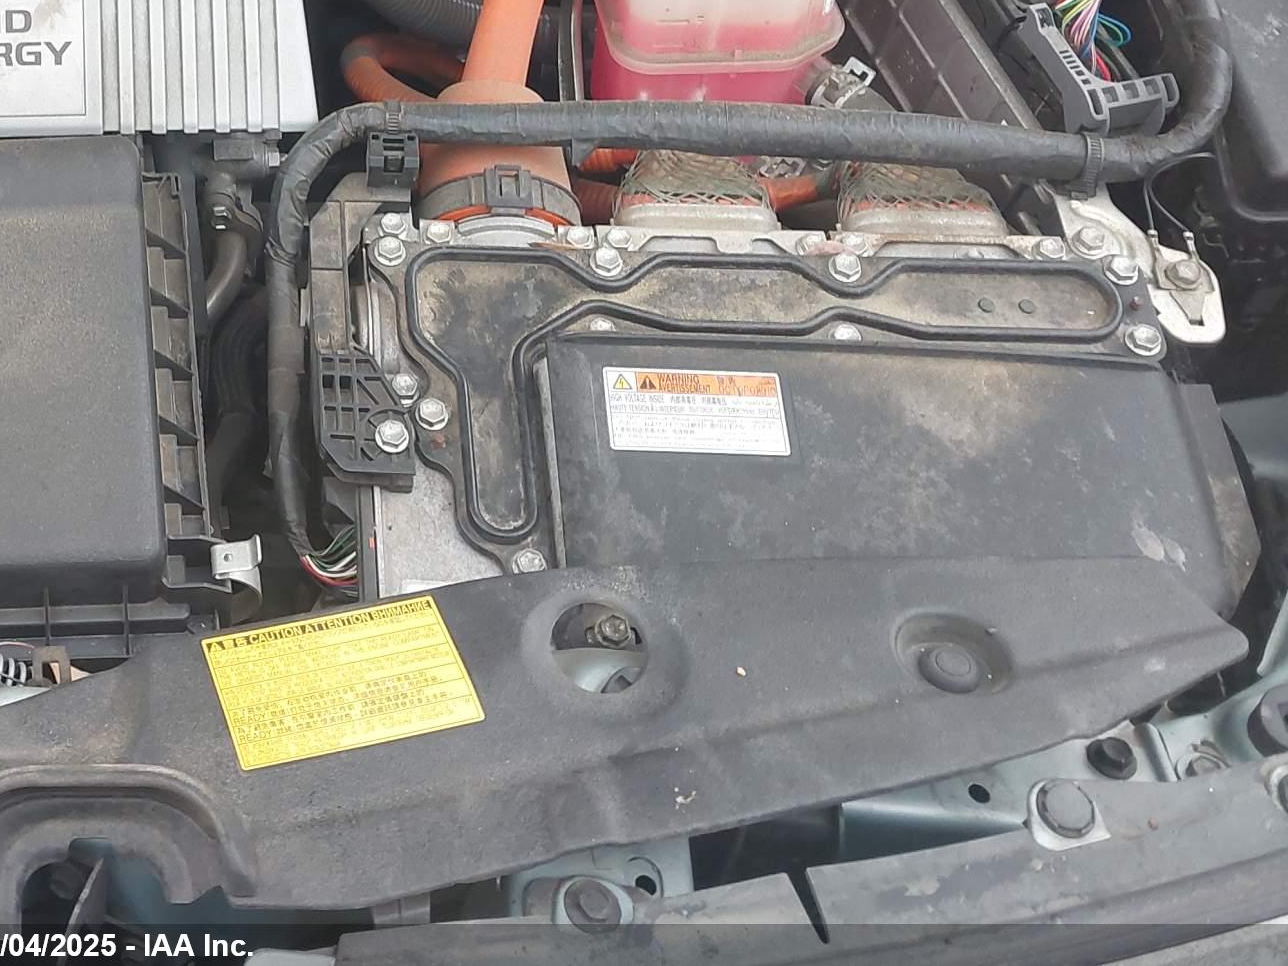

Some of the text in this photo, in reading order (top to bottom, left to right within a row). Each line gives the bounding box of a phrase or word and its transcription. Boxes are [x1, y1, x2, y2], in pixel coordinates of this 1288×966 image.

[657, 374, 700, 384] WARNING
[249, 626, 302, 644] CAUTION
[307, 613, 370, 634] ATTENTION
[372, 601, 430, 620] ВНИМАНИЕ
[233, 712, 266, 726] READY
[238, 729, 272, 743] READY
